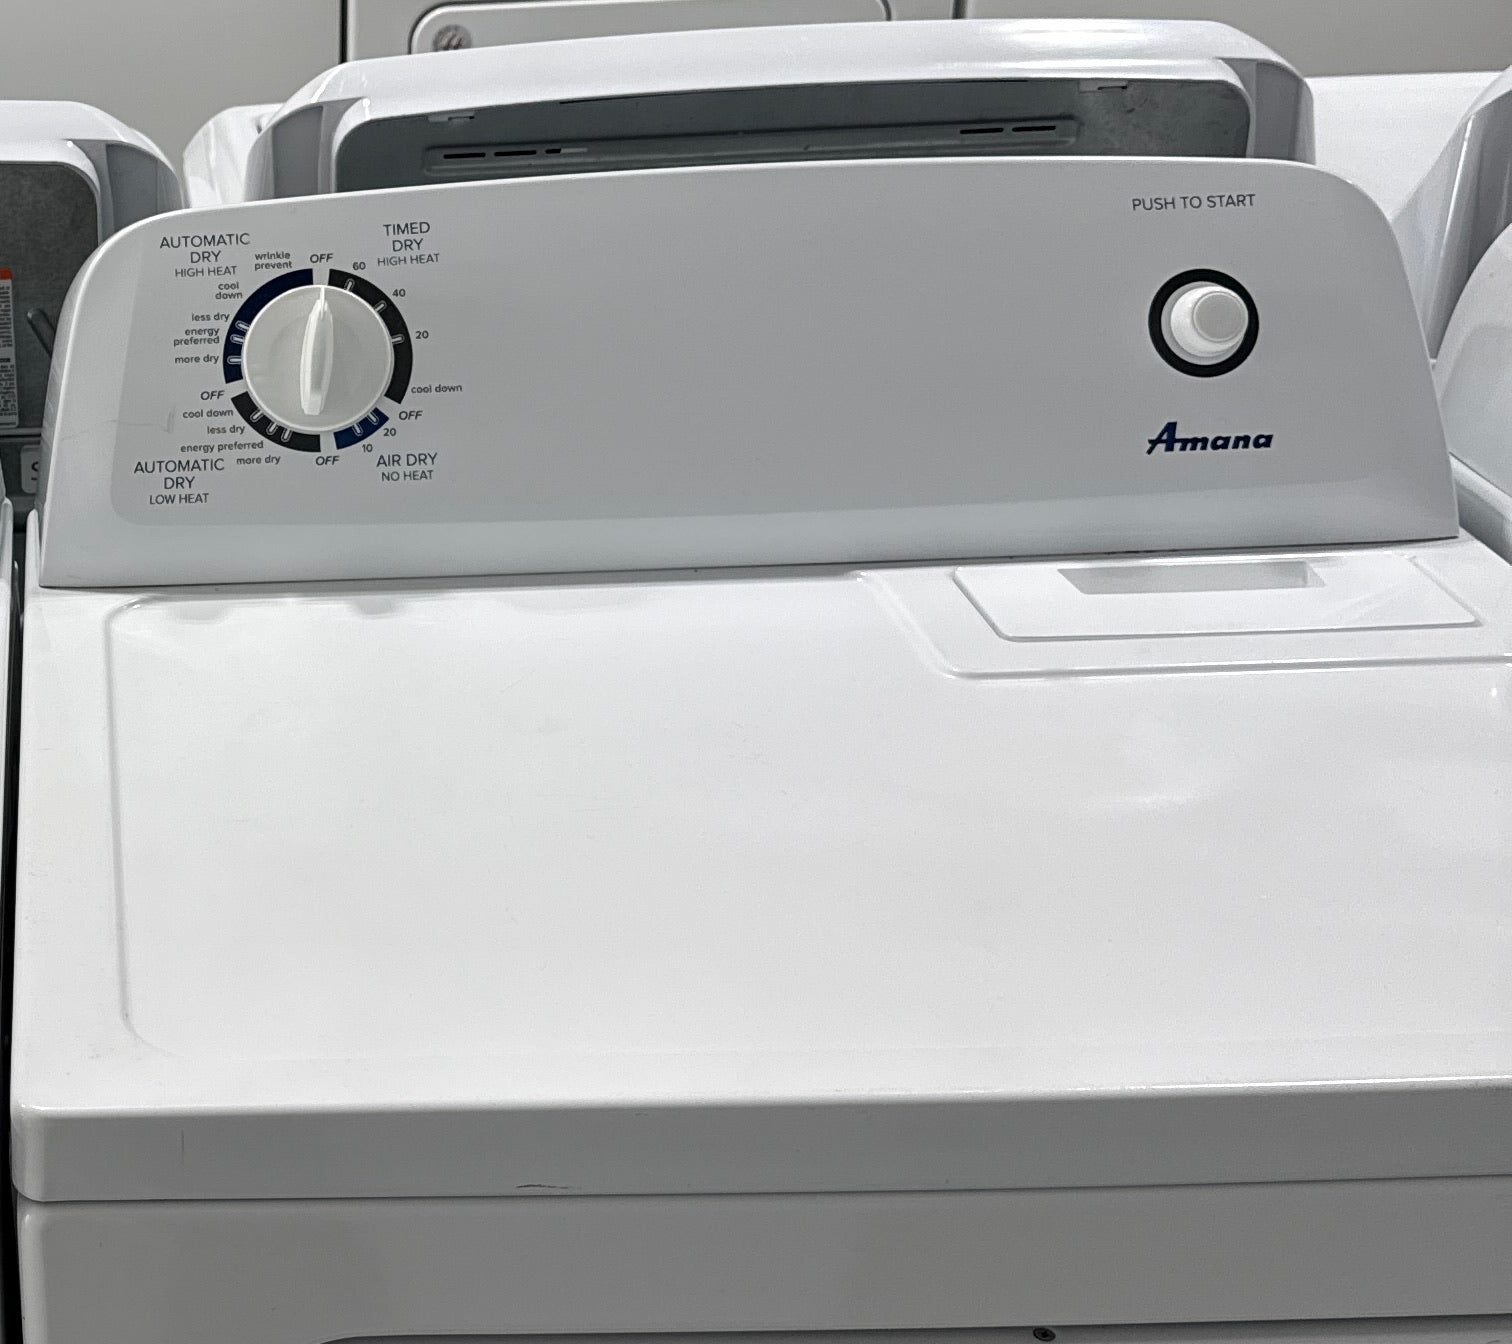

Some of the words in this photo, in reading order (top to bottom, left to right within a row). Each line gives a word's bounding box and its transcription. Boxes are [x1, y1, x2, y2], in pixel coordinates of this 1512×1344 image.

[1132, 197, 1176, 211] PUSH
[1179, 195, 1202, 210] TO
[1206, 193, 1256, 209] START
[383, 221, 431, 236] TIMED
[160, 233, 251, 249] AUTOMATIC
[392, 238, 424, 252] DRY
[190, 250, 222, 264] DRY
[255, 251, 291, 260] wrinkle
[310, 253, 334, 263] OFF
[377, 257, 406, 267] HIGH
[410, 253, 440, 264] HEAT
[255, 261, 292, 271] prevent
[352, 261, 366, 271] 60
[175, 268, 204, 278] HIGH
[208, 266, 238, 277] HEAT
[218, 282, 240, 291] cool
[215, 291, 243, 300] down
[392, 288, 406, 298] 40
[191, 313, 211, 322] less
[214, 312, 230, 322] dry
[184, 327, 220, 337] energy
[415, 330, 429, 340] 20
[173, 336, 220, 347] preferred
[175, 355, 201, 364] more
[203, 354, 219, 364] dry
[411, 384, 432, 394] cool
[434, 384, 463, 393] down
[200, 390, 225, 400] OFF
[183, 409, 203, 418] cool
[206, 408, 234, 417] down
[398, 410, 423, 421] OFF
[207, 425, 227, 434] less
[229, 425, 246, 435] dry
[383, 428, 397, 437] 20
[1146, 421, 1274, 455] Amana
[180, 443, 214, 454] energy
[217, 441, 264, 452] preferred
[362, 443, 373, 453] 10
[236, 457, 262, 465] more
[264, 455, 281, 465] dry
[315, 455, 340, 466] OFF
[376, 454, 401, 468] AIR
[406, 452, 438, 467] DRY
[133, 458, 225, 474] AUTOMATIC
[381, 471, 400, 482] NO
[403, 470, 434, 481] HEAT
[164, 476, 195, 490] DRY
[149, 494, 176, 505] LOW
[179, 492, 209, 504] HEAT
